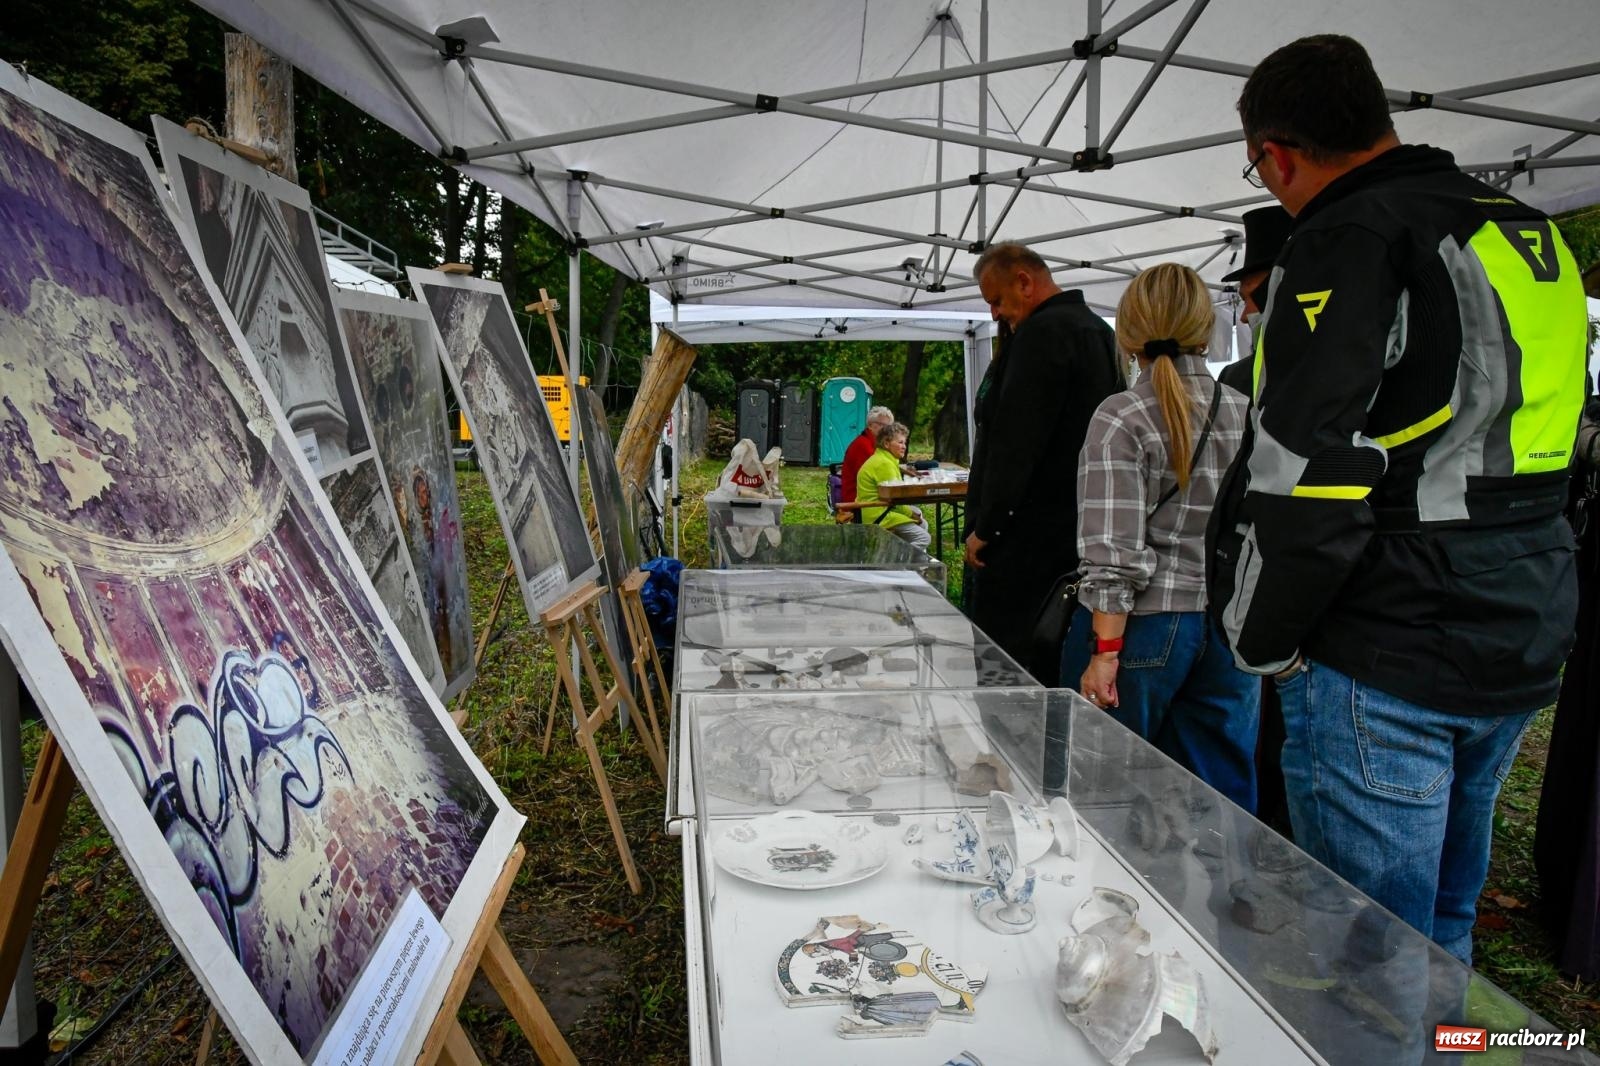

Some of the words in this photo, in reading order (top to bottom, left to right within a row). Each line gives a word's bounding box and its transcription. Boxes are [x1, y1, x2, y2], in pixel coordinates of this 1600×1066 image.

[346, 1017, 371, 1063] znajdująca
[368, 1005, 379, 1020] się
[374, 995, 383, 1008] na
[380, 958, 403, 1000] pierwszym
[400, 937, 414, 964] piętrze
[409, 916, 425, 940] lewego
[362, 1037, 379, 1066] pałacu
[375, 1031, 381, 1041] z
[378, 972, 411, 1037] pozostałościami
[407, 940, 427, 977] malowideł
[422, 935, 431, 946] na
